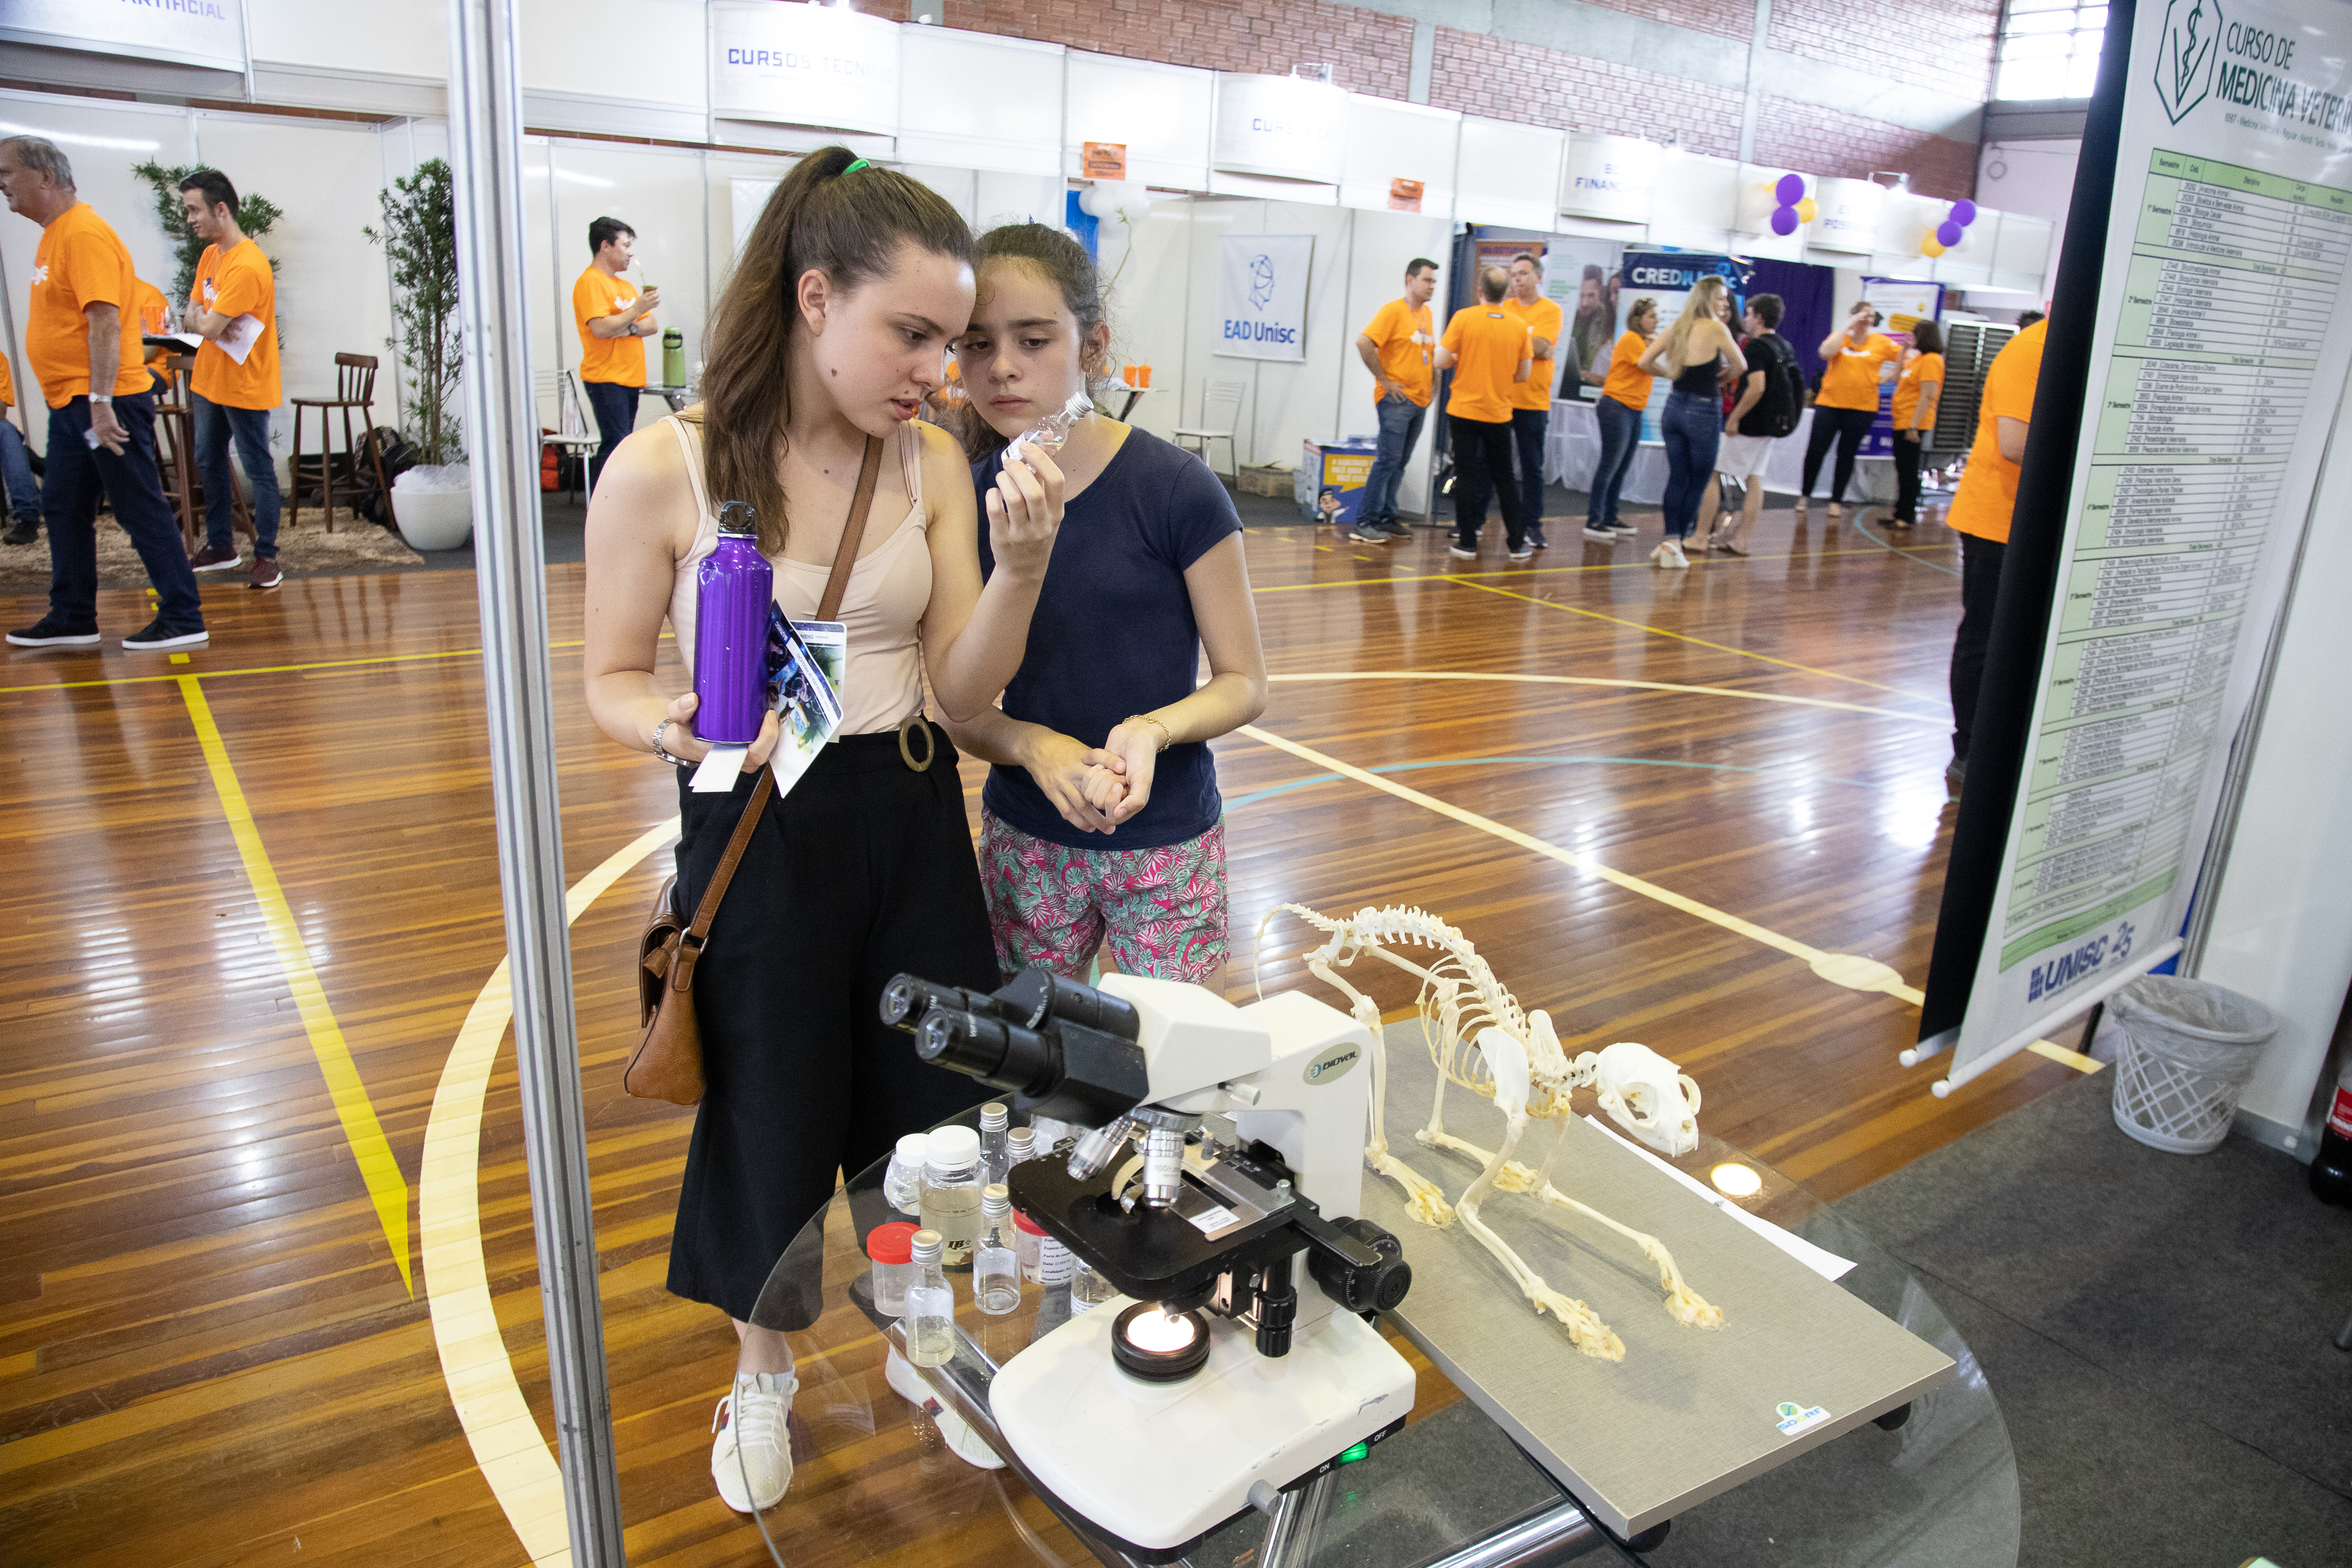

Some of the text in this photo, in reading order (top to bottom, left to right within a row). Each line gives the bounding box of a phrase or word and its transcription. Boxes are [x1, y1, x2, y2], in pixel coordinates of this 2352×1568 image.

[2227, 22, 2296, 70] CURSO DE
[728, 48, 810, 69] CURSOS
[2216, 61, 2297, 119] MEDICINA
[1224, 320, 1295, 344] EAD Unisc
[2045, 935, 2109, 991] UNISC
[1374, 1430, 1387, 1442] OFF
[1319, 1463, 1329, 1473] ON
